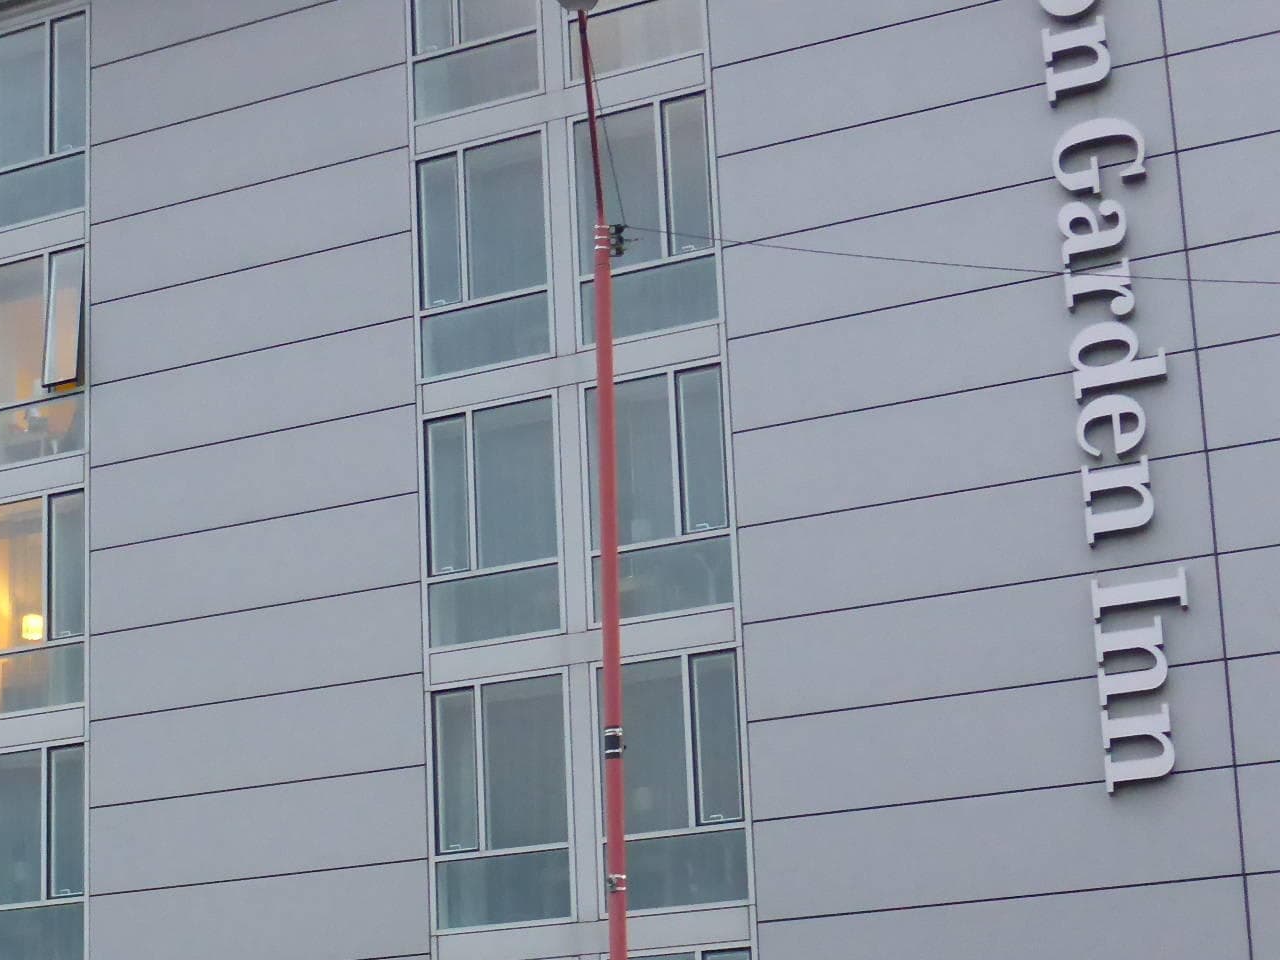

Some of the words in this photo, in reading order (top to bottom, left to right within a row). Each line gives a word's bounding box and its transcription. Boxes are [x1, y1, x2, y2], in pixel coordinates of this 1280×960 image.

[1040, 0, 1112, 107] n
[1052, 117, 1167, 545] Garden
[1091, 566, 1188, 794] Inn
